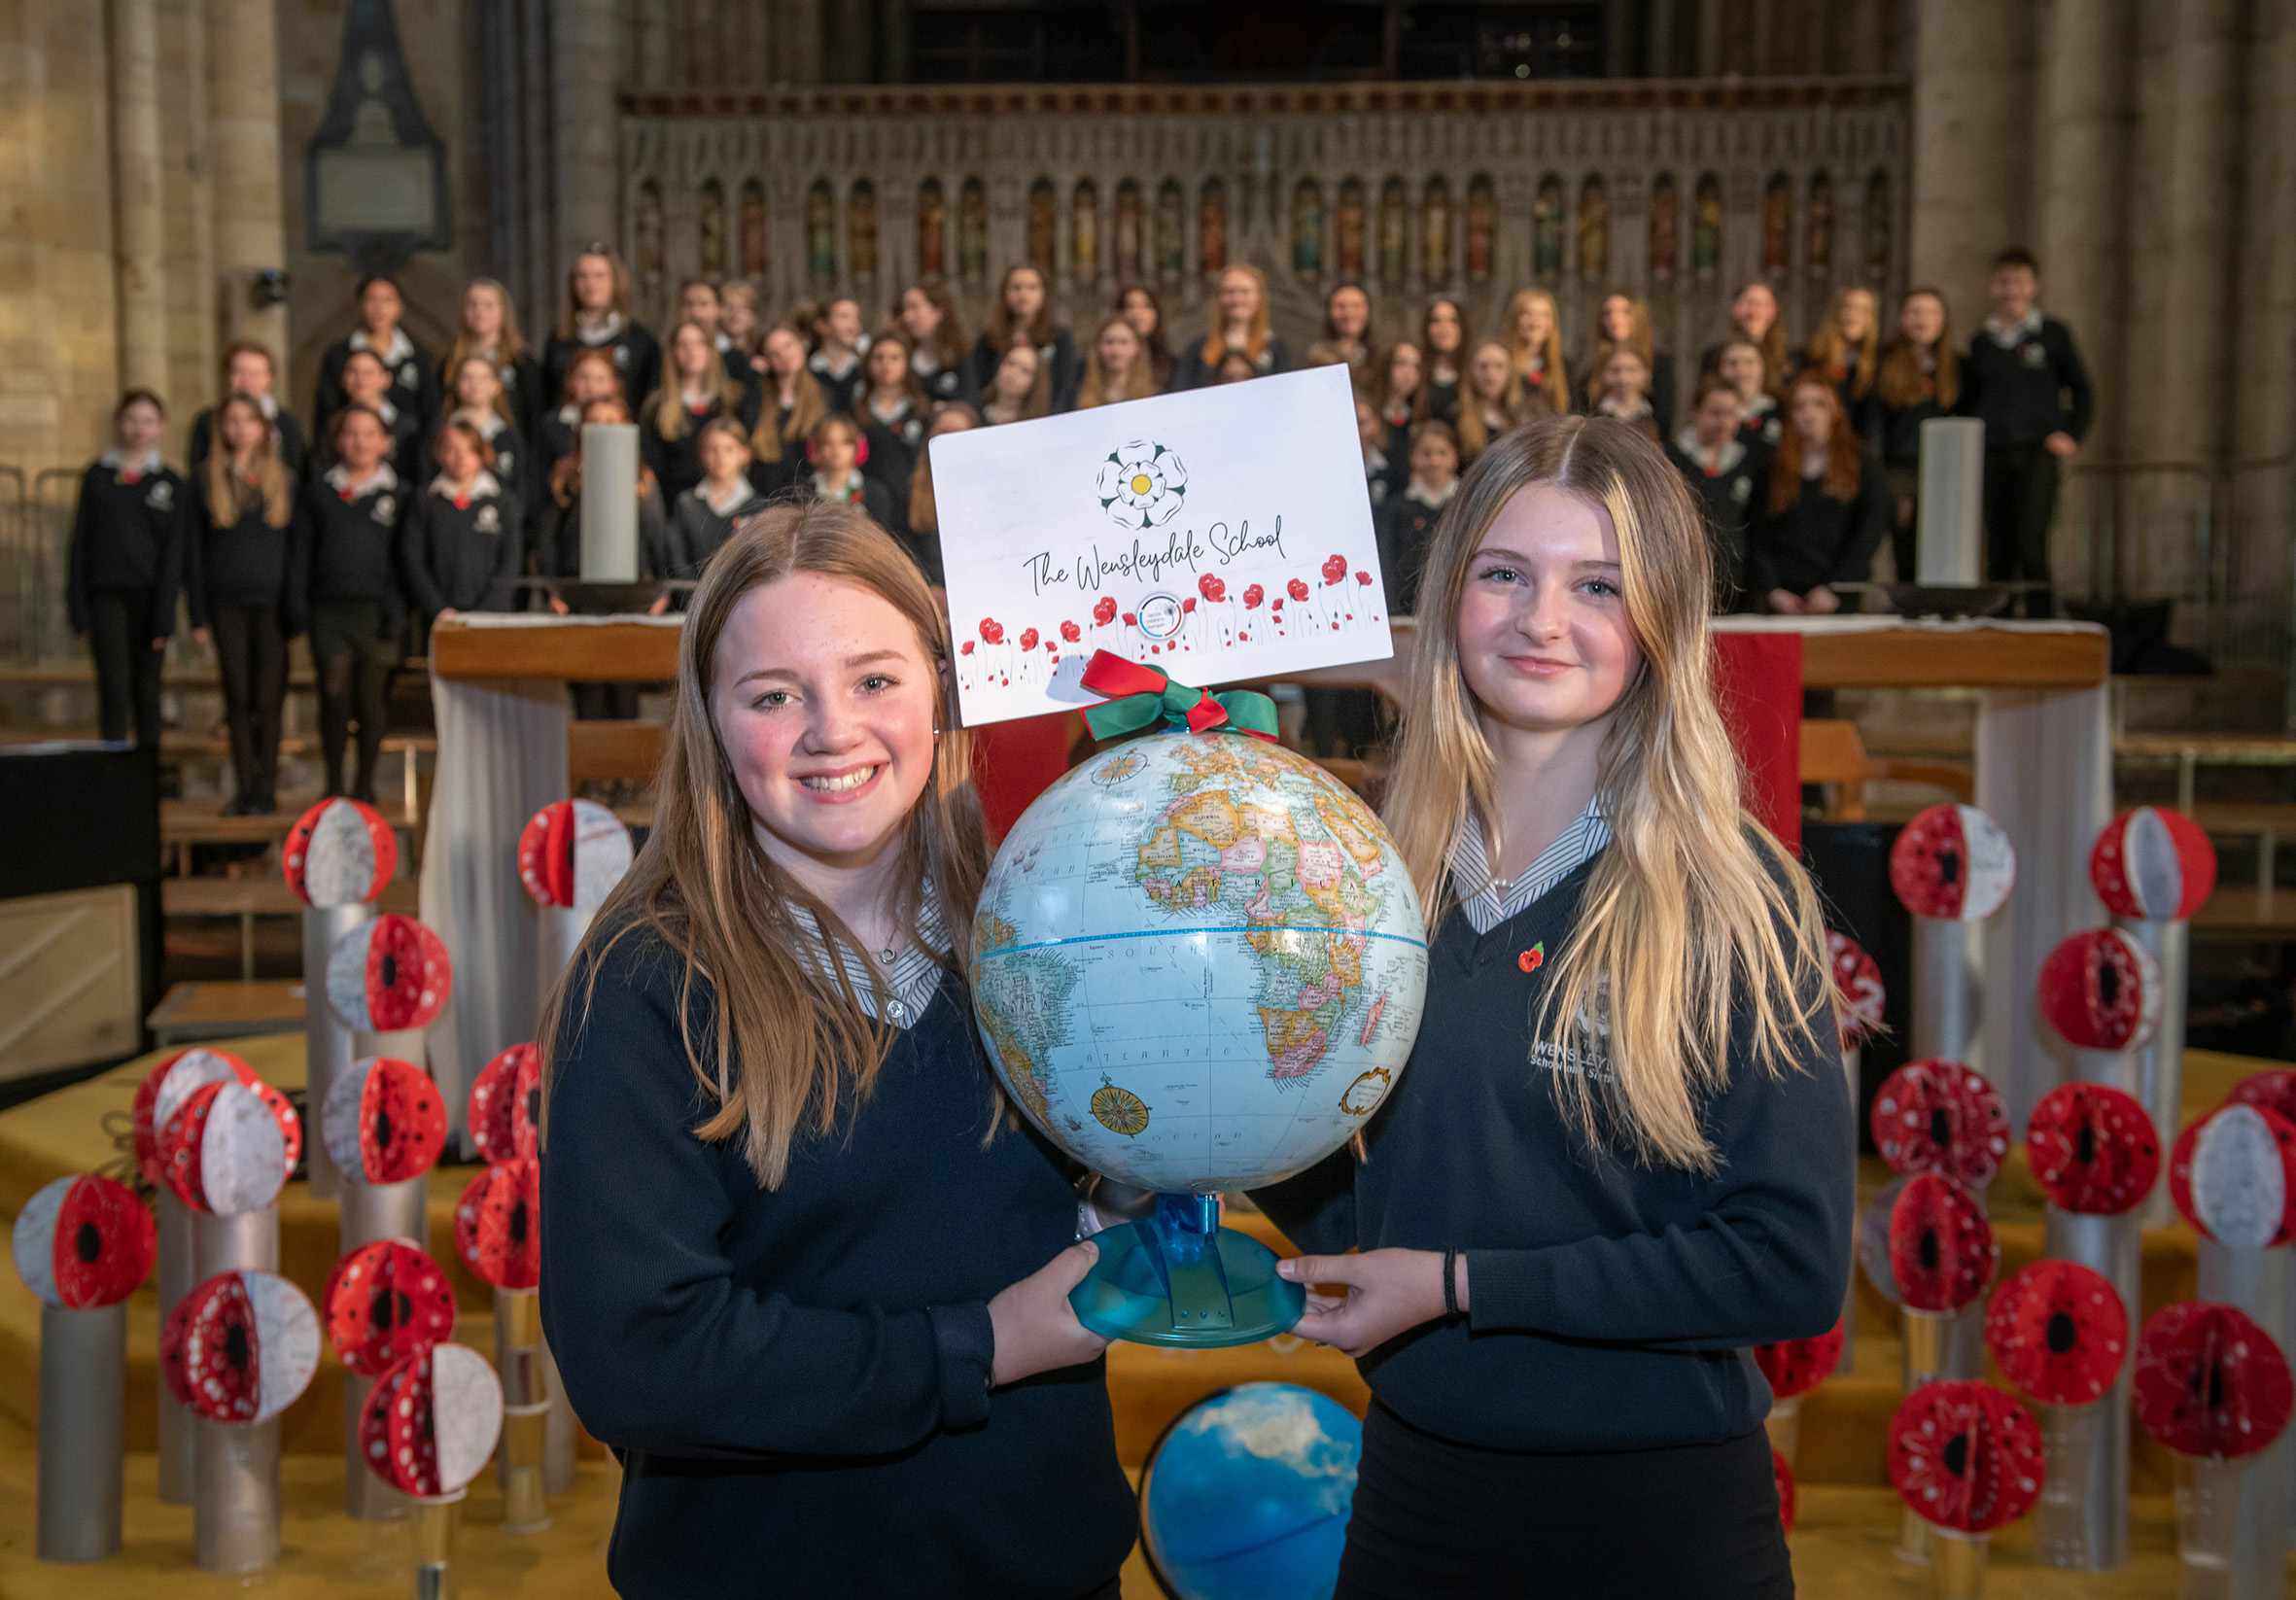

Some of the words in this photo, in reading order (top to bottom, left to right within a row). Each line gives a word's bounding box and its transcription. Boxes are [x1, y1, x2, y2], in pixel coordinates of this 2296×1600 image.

[1023, 551, 1068, 597] The
[1076, 529, 1204, 591] Wensleydale
[1208, 514, 1285, 566] School
[1105, 945, 1198, 958] SOUTH
[1087, 1047, 1230, 1063] ATLANTIC
